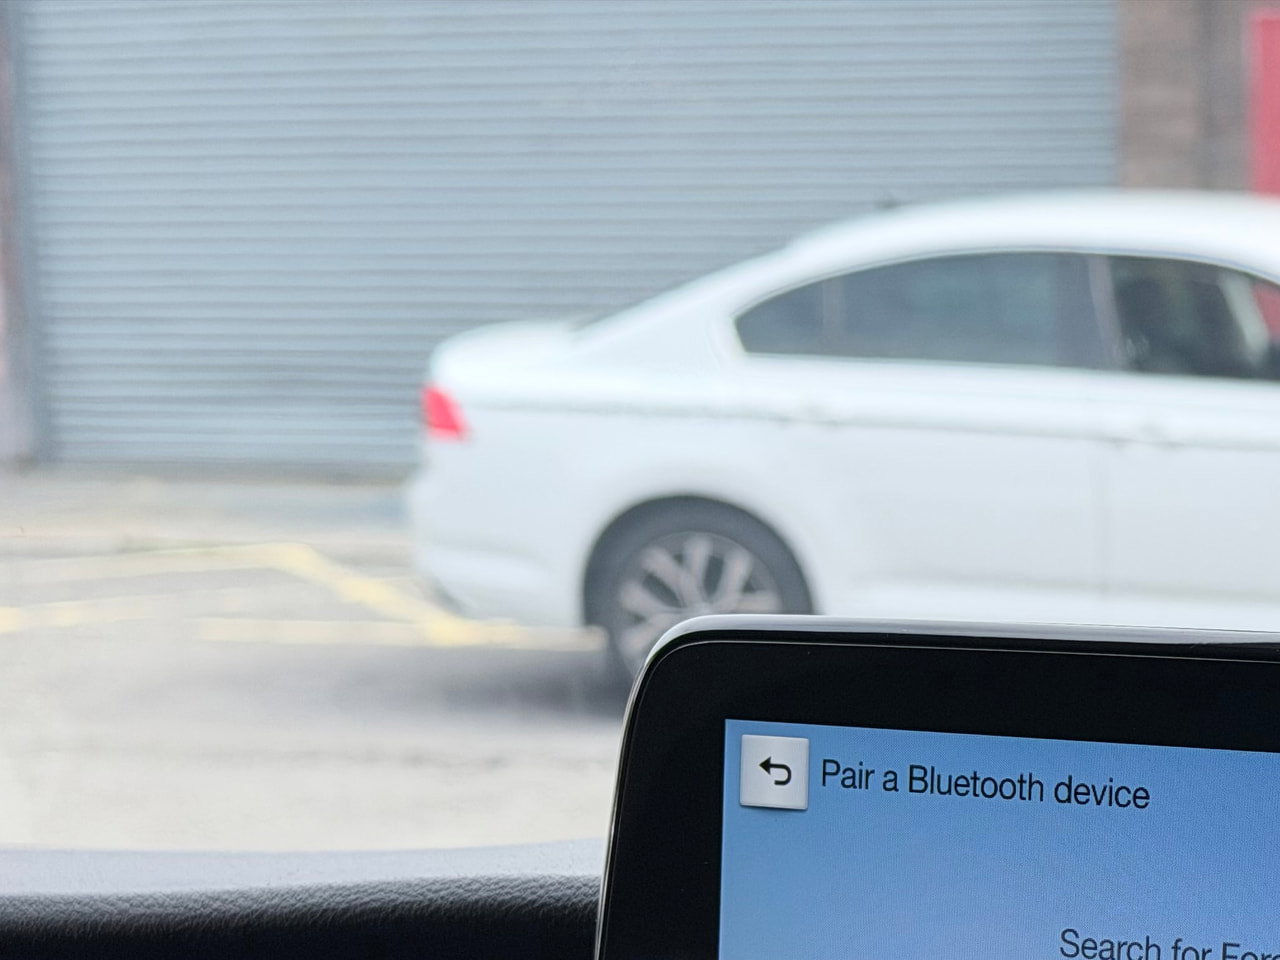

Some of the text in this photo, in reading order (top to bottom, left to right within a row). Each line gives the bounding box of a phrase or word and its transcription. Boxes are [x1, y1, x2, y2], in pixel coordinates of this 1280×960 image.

[821, 759, 1150, 809] Pair a Bluetooth device
